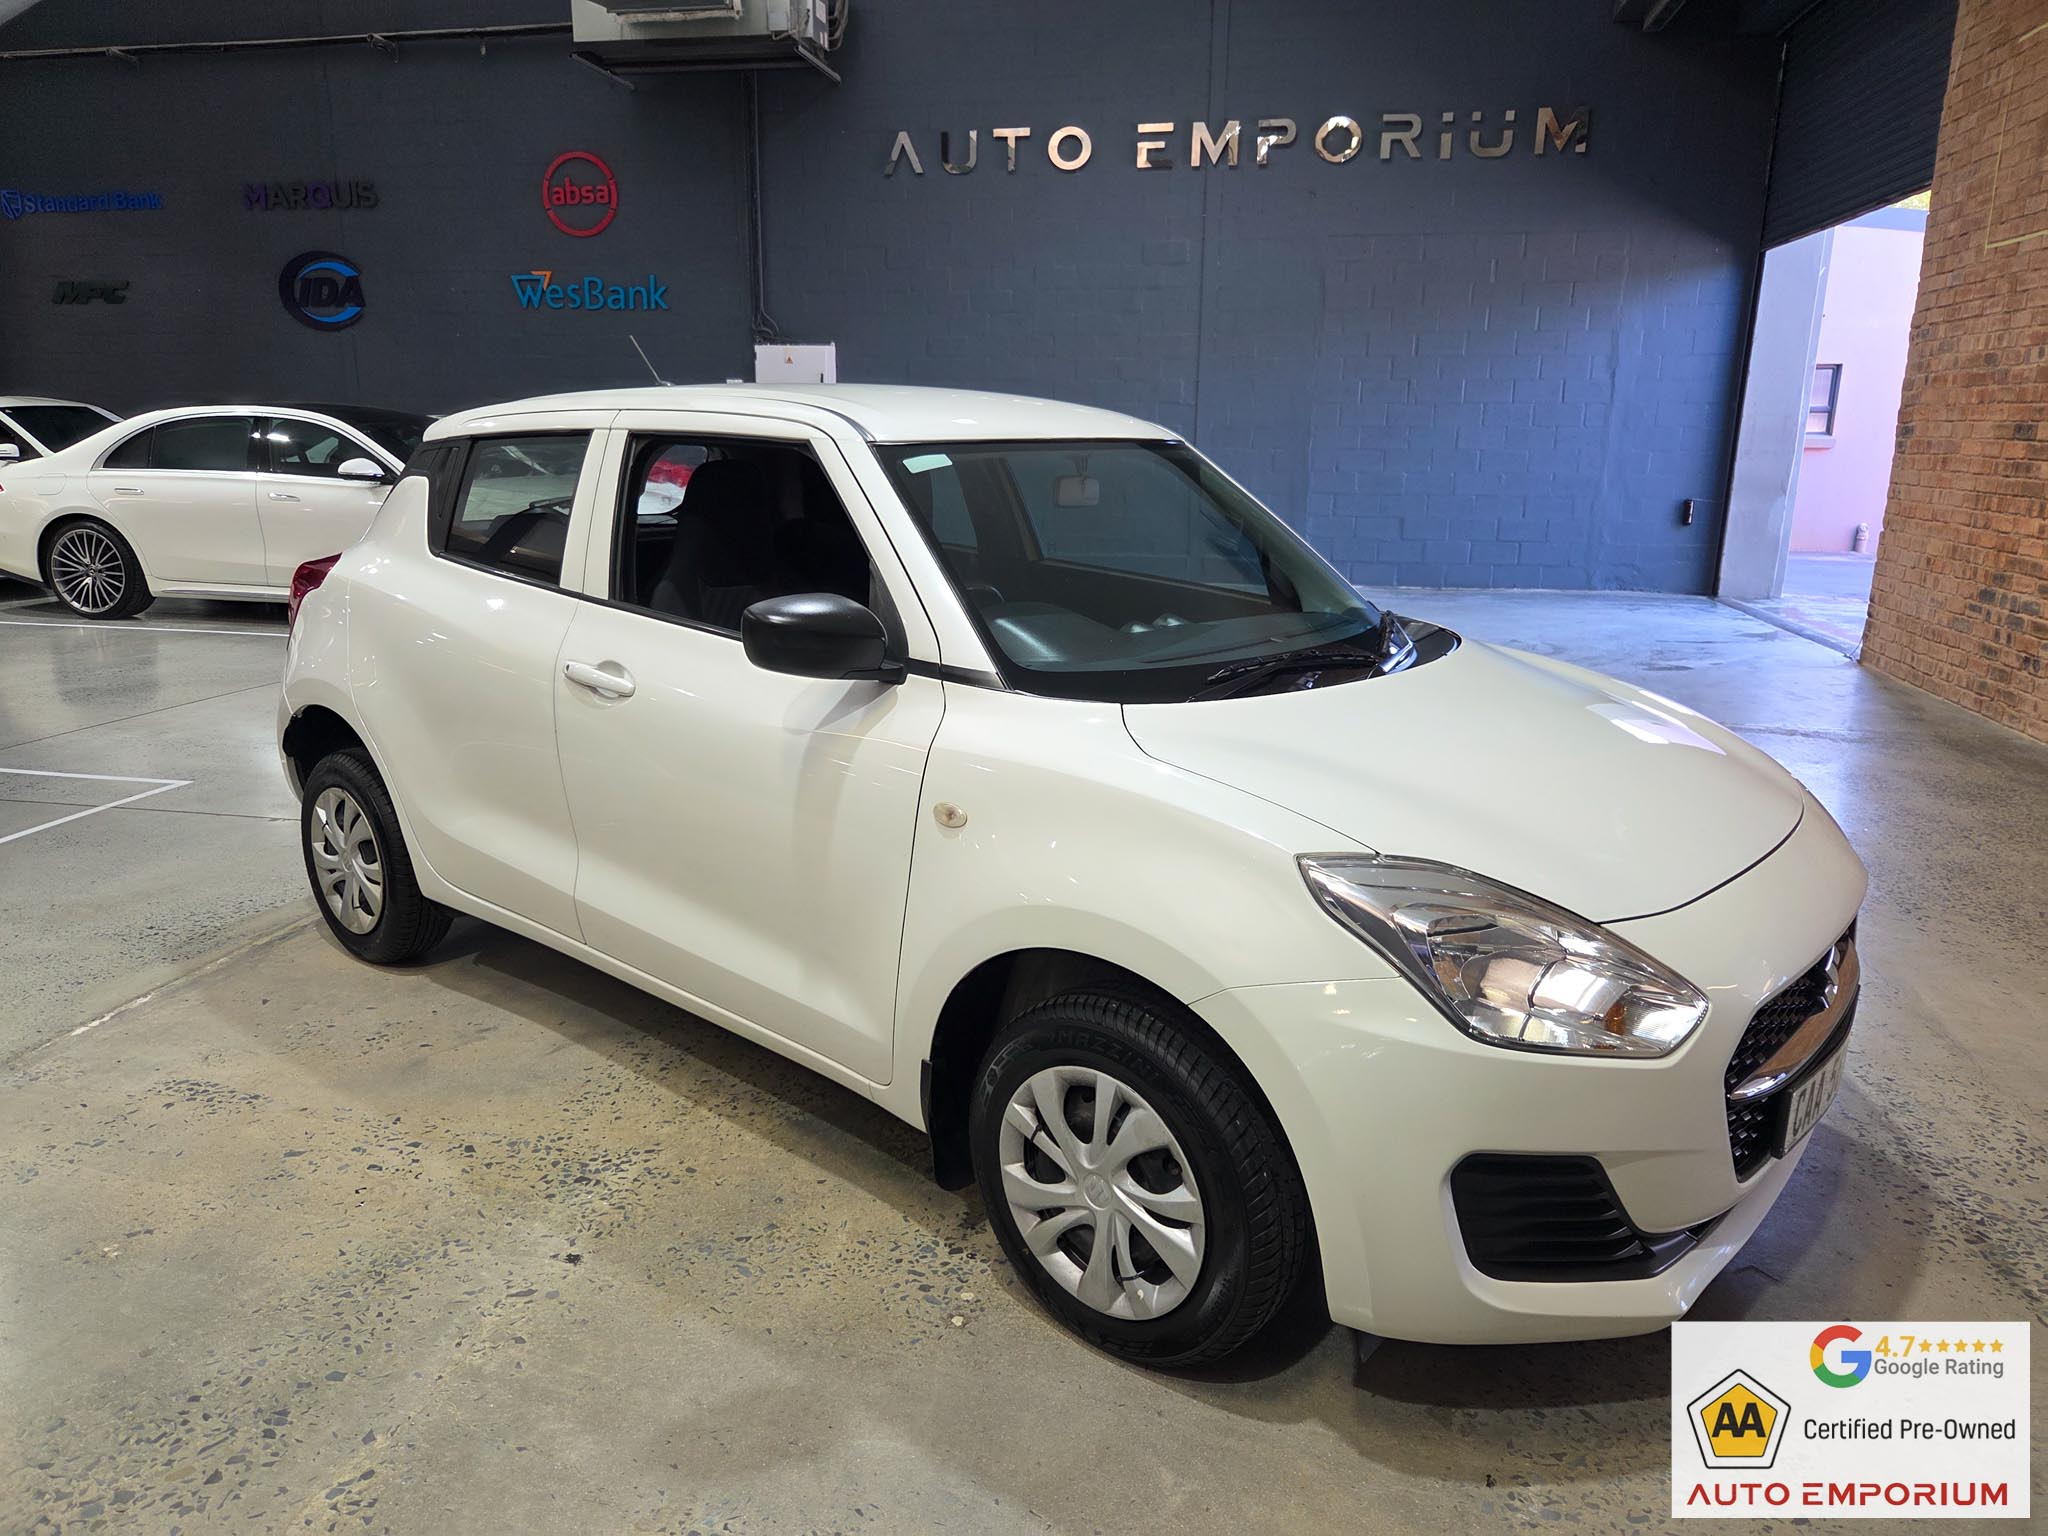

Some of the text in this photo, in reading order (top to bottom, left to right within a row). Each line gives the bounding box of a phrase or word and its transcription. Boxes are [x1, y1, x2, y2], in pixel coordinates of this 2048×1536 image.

[884, 126, 1093, 176] AUTO
[23, 191, 163, 214] Standard Bank
[241, 180, 379, 210] MARQUIS
[551, 176, 611, 206] absa
[511, 270, 669, 311] WesBank
